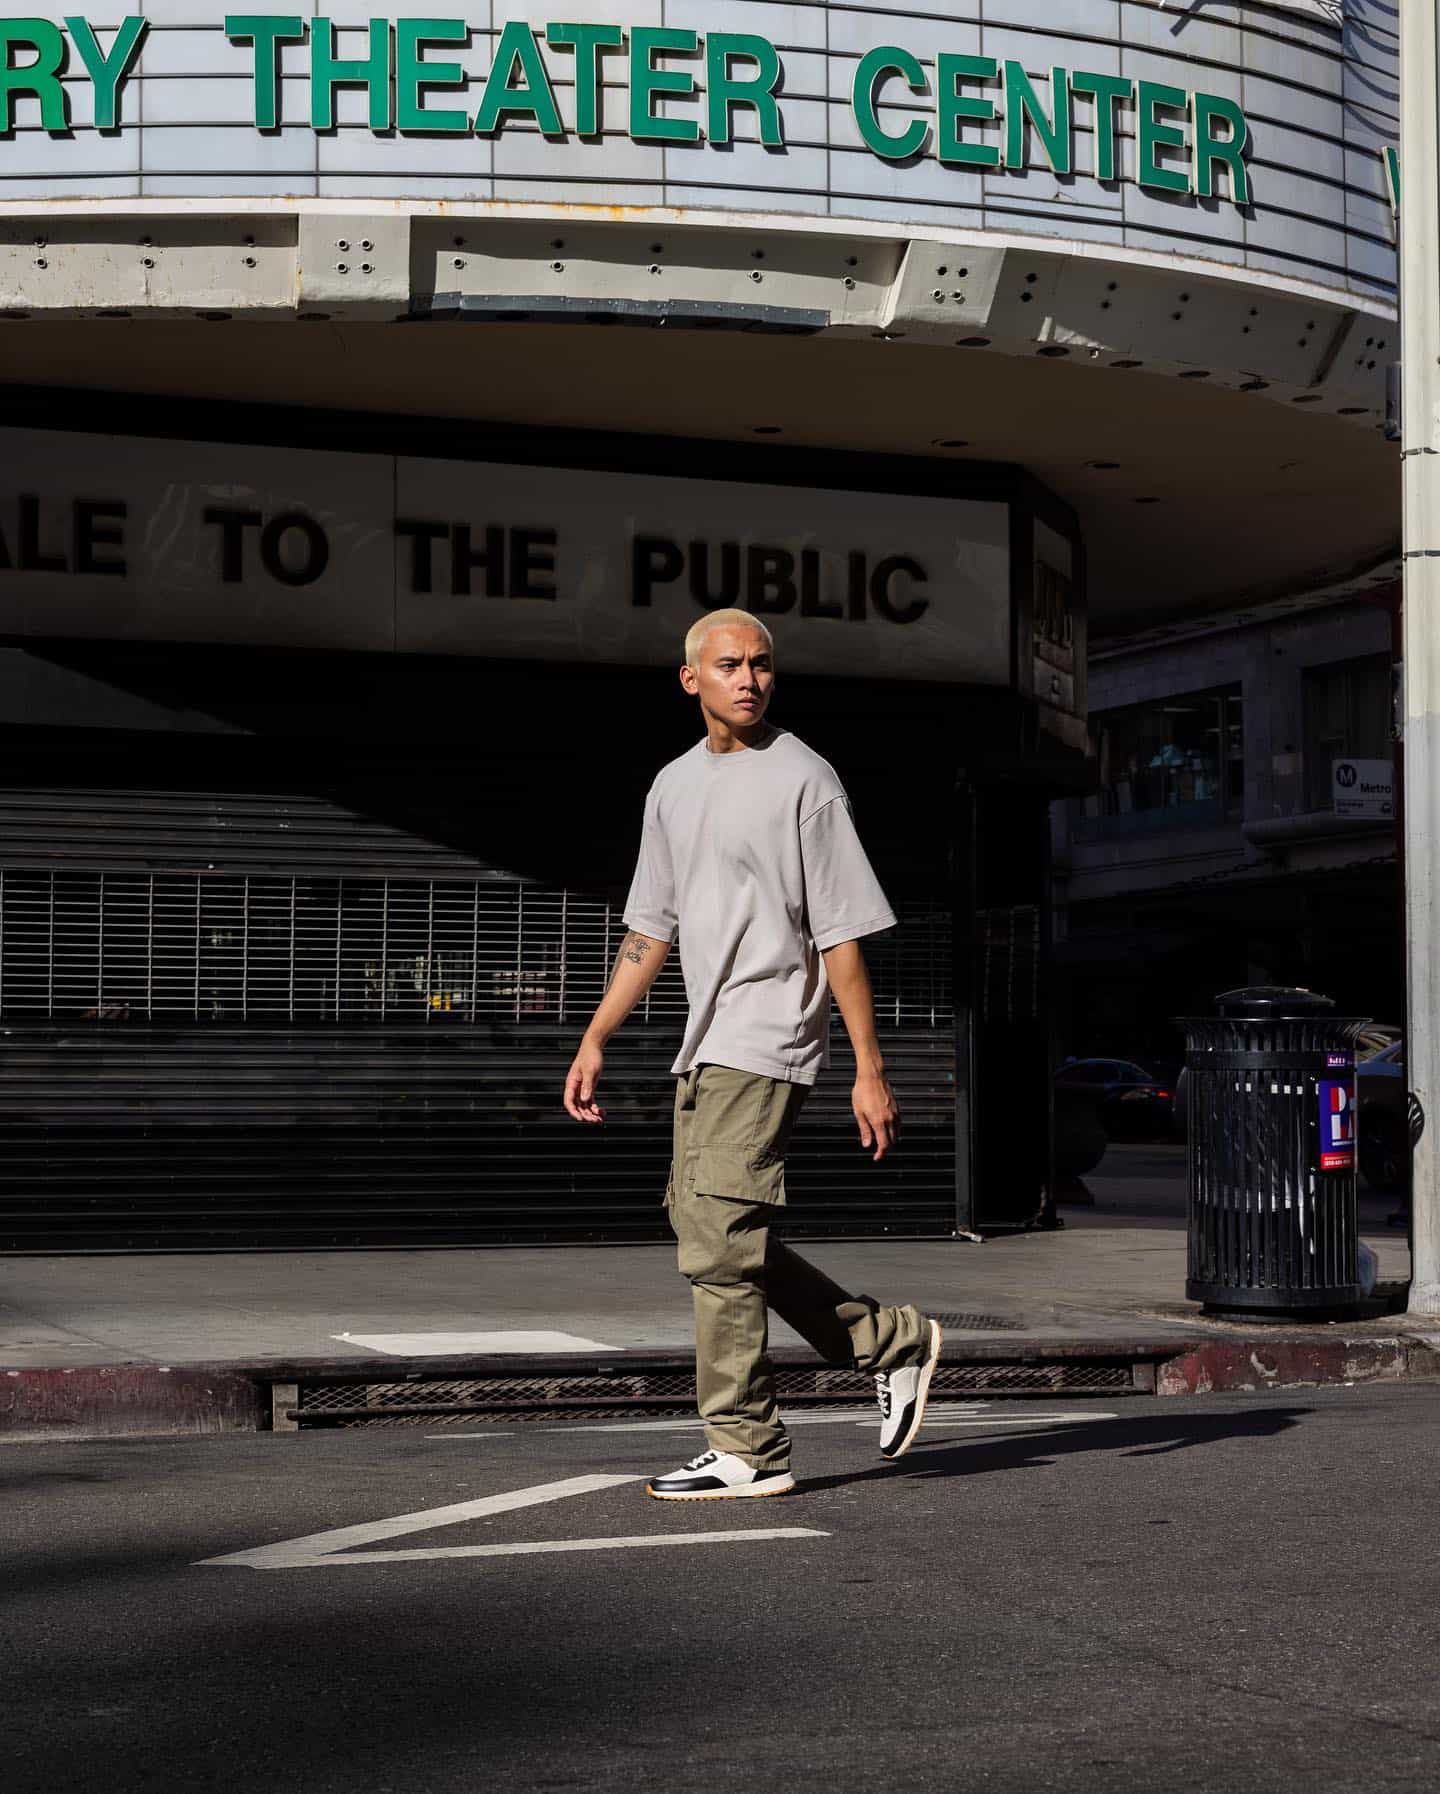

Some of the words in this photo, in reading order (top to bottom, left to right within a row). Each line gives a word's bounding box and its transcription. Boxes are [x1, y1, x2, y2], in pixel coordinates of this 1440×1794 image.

[0, 16, 148, 132] RY
[224, 15, 783, 147] THEATER
[850, 46, 1250, 204] CENTER
[0, 495, 126, 575] LE
[204, 509, 329, 586] TO
[395, 520, 557, 599] THE
[633, 535, 929, 624] PUBLIC
[1360, 783, 1392, 793] Metro
